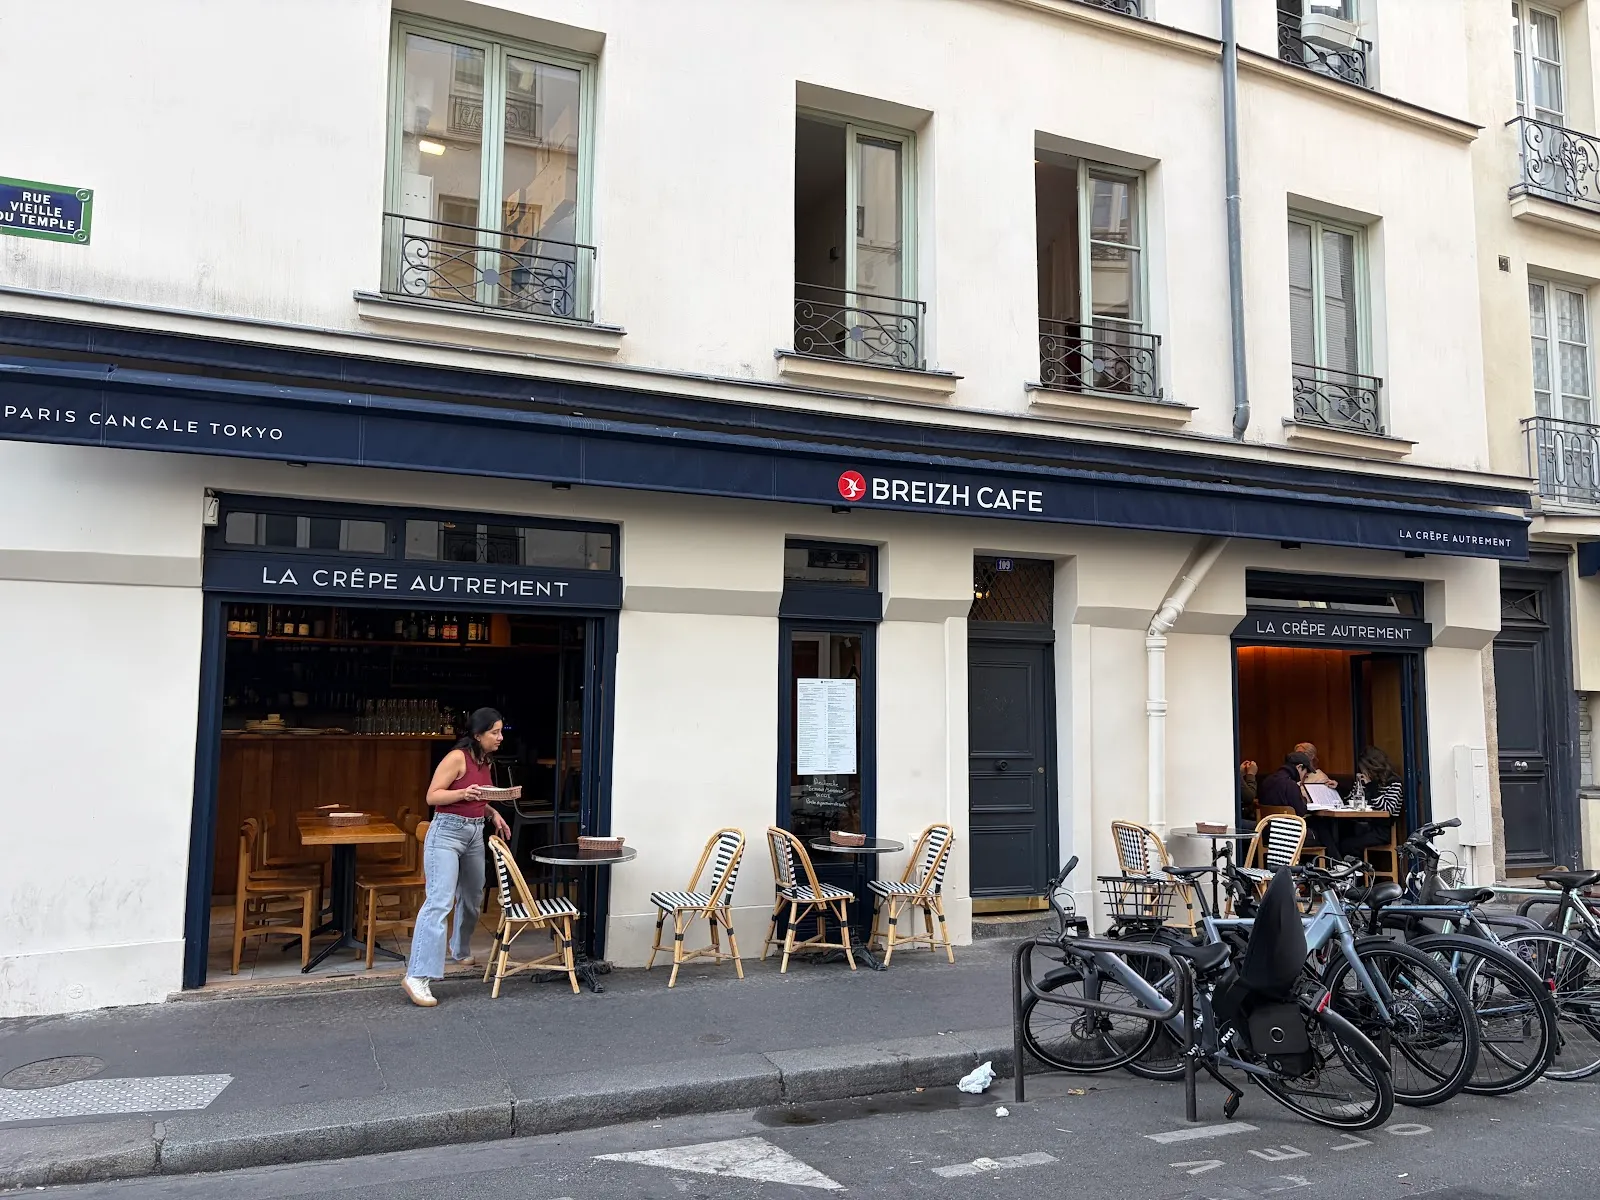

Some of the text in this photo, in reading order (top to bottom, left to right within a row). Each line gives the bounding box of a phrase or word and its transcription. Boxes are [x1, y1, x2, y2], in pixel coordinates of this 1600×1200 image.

[22, 191, 51, 205] RUE
[10, 201, 62, 218] VIEILLE
[20, 213, 75, 231] TEMPLE
[4, 405, 283, 440] PARIS CANCALE TOKYO
[872, 477, 1043, 513] BREIZH CAFE
[1399, 529, 1512, 548] LA CRÊPE AUTREMENT
[998, 559, 1011, 570] 109
[262, 566, 569, 597] LA CRÊPE AUTREMENT
[1256, 619, 1412, 640] LA CRÊPE AUTREMENT
